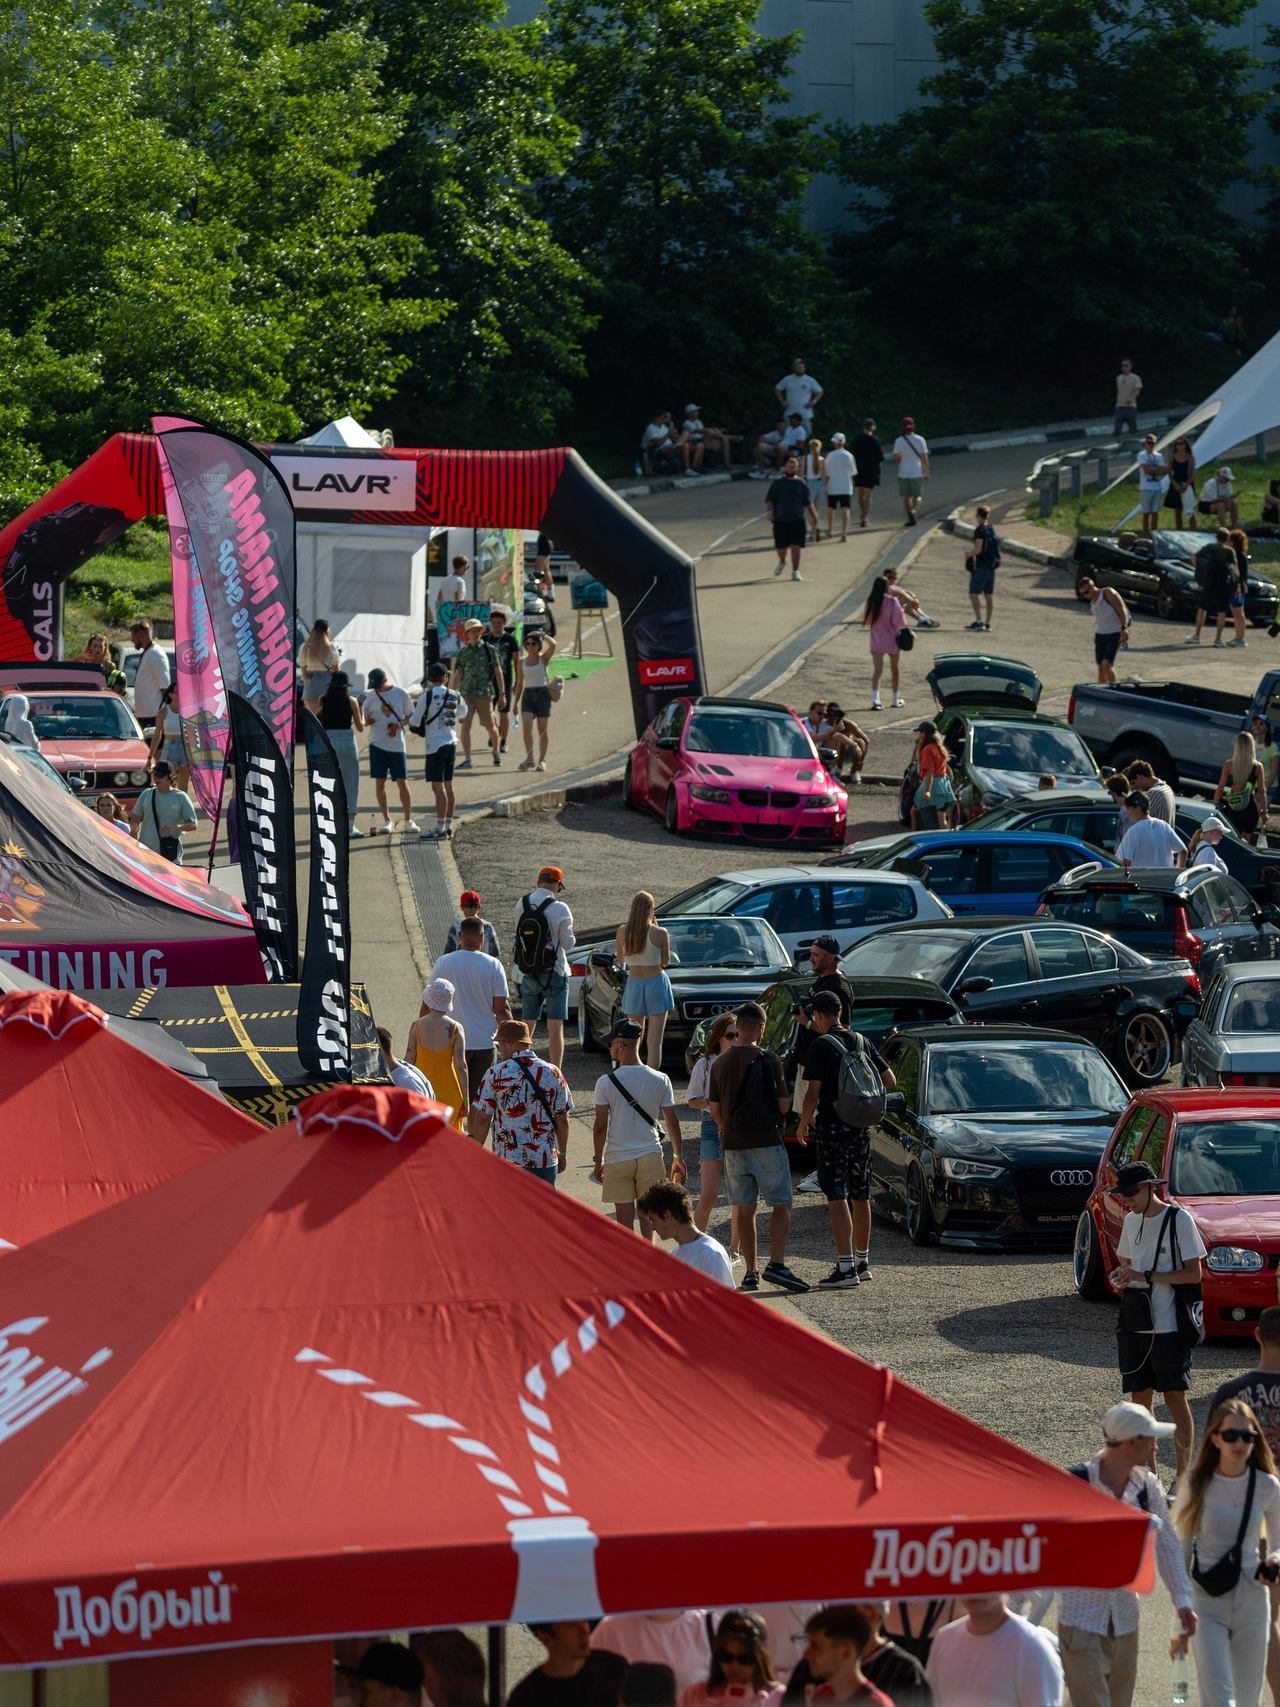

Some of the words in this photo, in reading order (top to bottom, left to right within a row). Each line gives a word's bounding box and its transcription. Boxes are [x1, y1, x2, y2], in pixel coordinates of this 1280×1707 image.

[292, 472, 391, 494] LAVR
[646, 665, 686, 677] LAVR
[865, 1524, 1040, 1587] Добрый
[53, 1571, 231, 1649] Добрый
